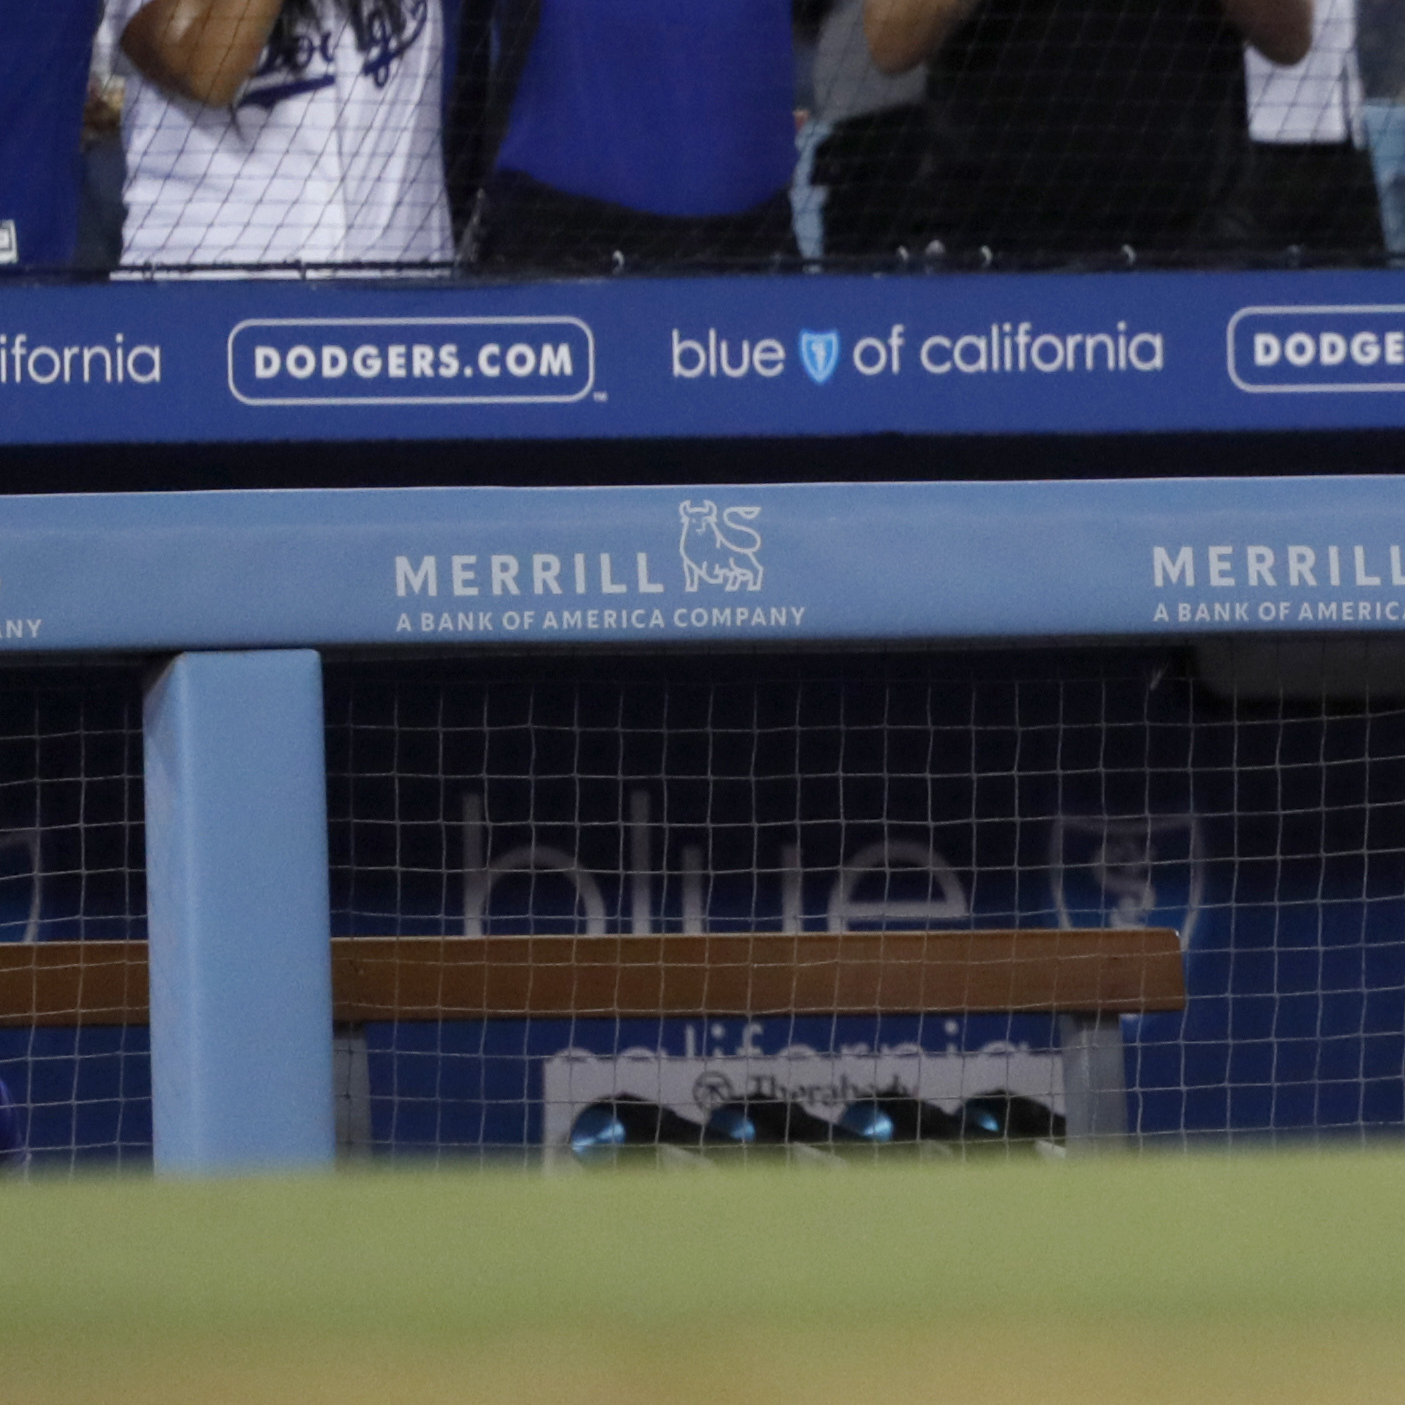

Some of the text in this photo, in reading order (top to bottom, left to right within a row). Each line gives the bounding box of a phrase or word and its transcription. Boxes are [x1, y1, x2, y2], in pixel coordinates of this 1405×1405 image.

[0, 333, 161, 385] ifornia
[254, 342, 574, 379] DODGERS.COM
[672, 321, 1164, 379] blue of california
[395, 552, 665, 597] MERRILL
[0, 618, 43, 639] NY
[395, 606, 807, 633] A BANK OF AMERICA COMPANY
[1152, 602, 1170, 622] A
[1177, 601, 1250, 622] BANK
[1258, 601, 1291, 621] OF
